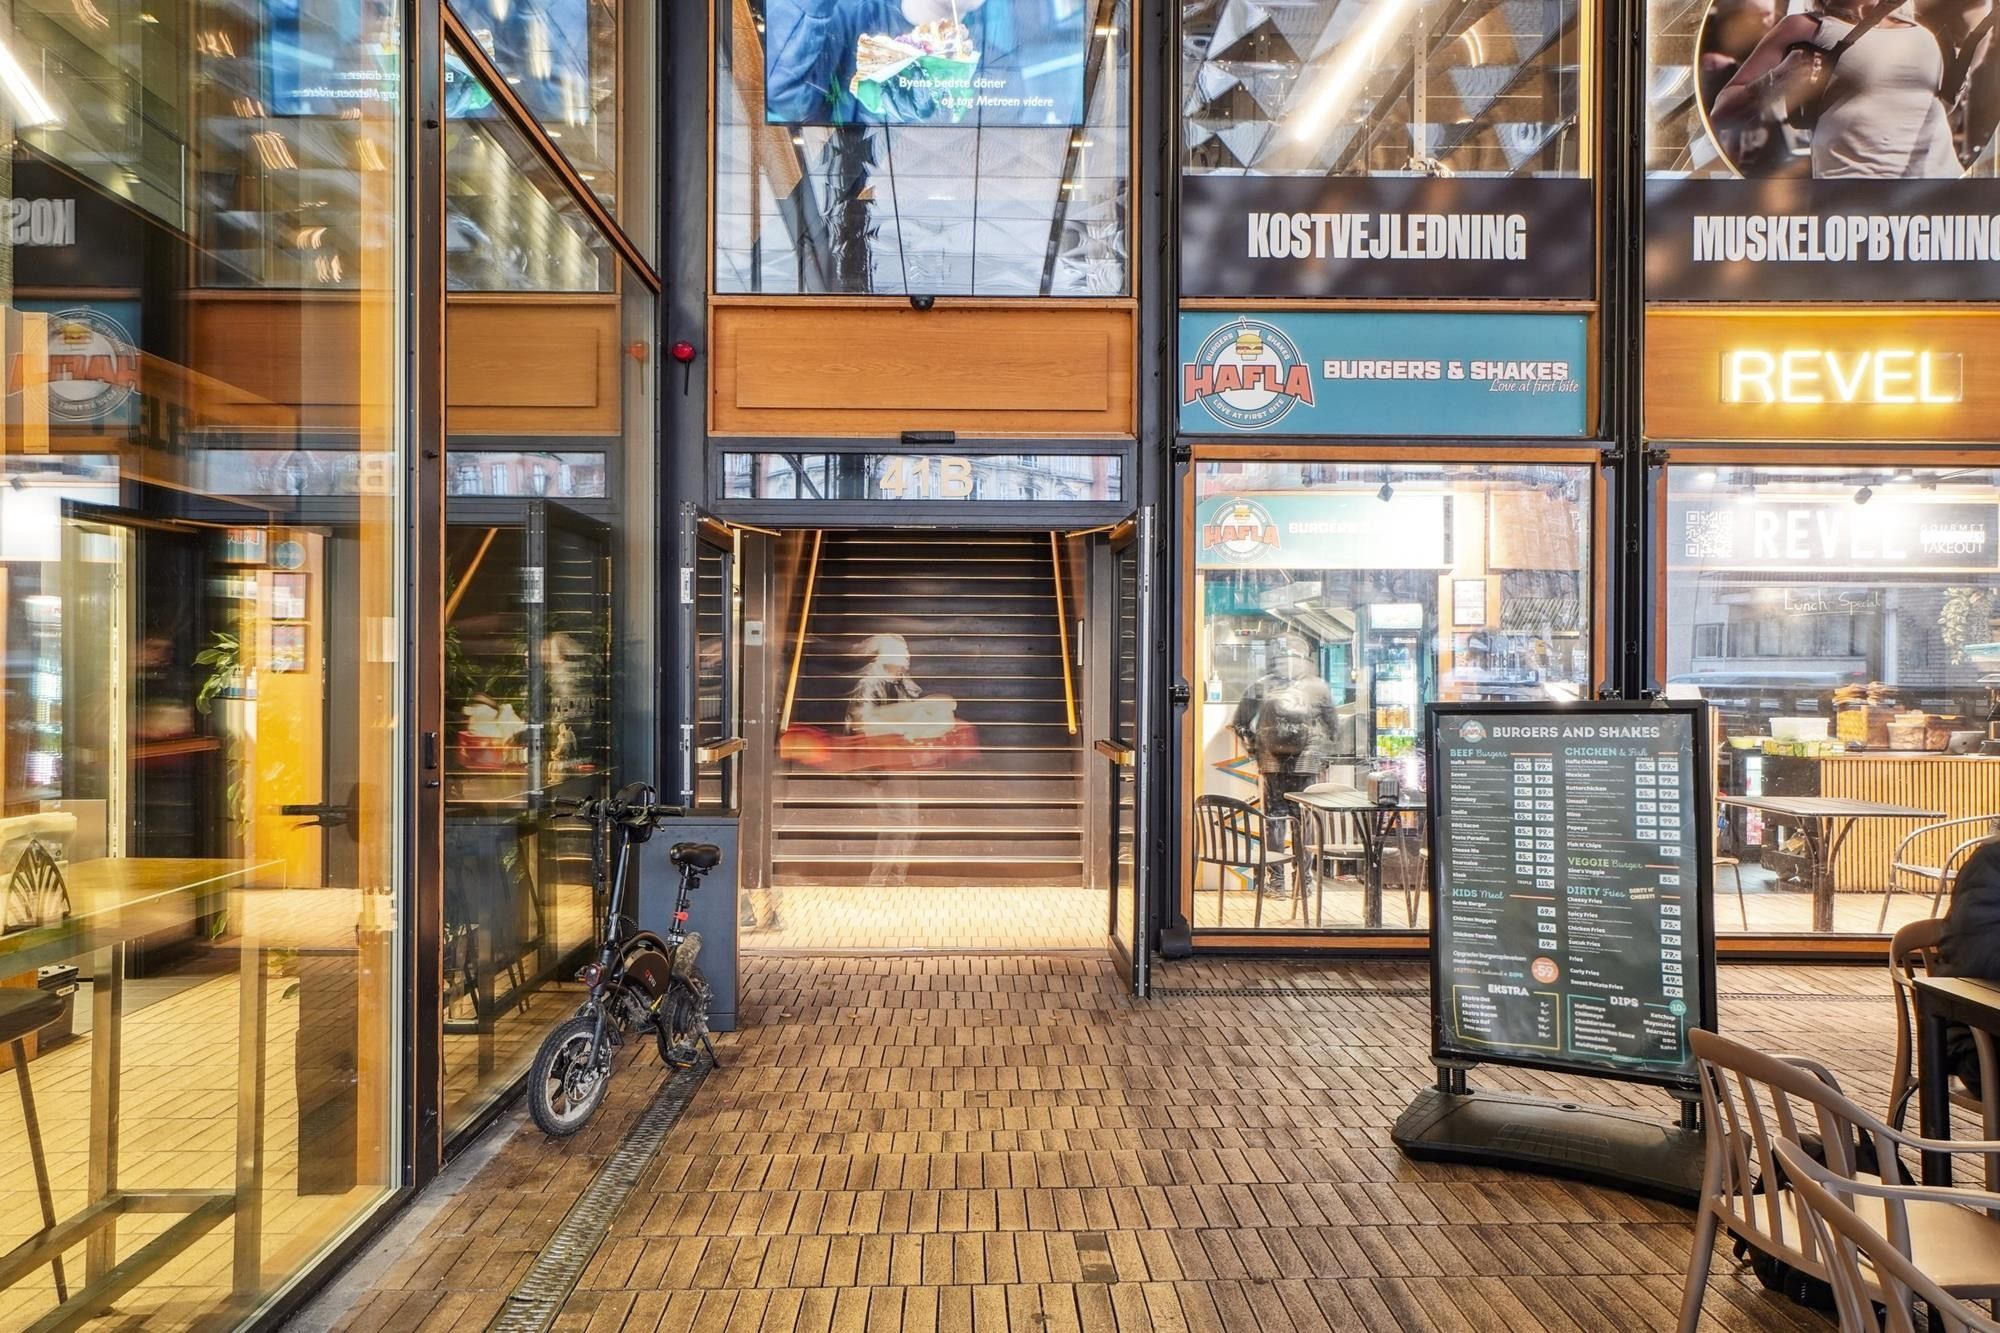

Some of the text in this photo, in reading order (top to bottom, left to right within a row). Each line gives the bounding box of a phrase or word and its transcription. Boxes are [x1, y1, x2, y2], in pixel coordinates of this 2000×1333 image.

[899, 78, 1006, 90] Byens bedste döner
[942, 96, 1054, 107] og tog Metroen videre
[1248, 212, 1526, 260] KOSTVEJLEDNING
[1206, 332, 1234, 361] BURGERS
[1266, 334, 1291, 360] SHAKES
[1322, 360, 1569, 380] BURGERS & SHAKES
[1731, 350, 1955, 403] REVEL
[1183, 363, 1315, 407] HAFLA
[1489, 379, 1579, 395] Love at first bite
[1213, 399, 1231, 415] LOVE
[1244, 411, 1268, 420] FIRST
[1268, 399, 1284, 414] BITE
[879, 456, 973, 497] 41B
[1203, 523, 1281, 550] HAFLA
[1784, 589, 1880, 615] Lunch Special
[1492, 726, 1660, 738] BURGERS AND SHAKES
[1450, 749, 1508, 759] BEEF Burgers
[1565, 748, 1617, 756] CHICKEN
[1568, 857, 1643, 871] VEGGIE Burger
[1452, 889, 1504, 899] KIDS Meal
[1567, 886, 1626, 898] DIRTY Fries
[1488, 984, 1530, 997] EKSTRA
[1610, 996, 1639, 1007] DIPS
